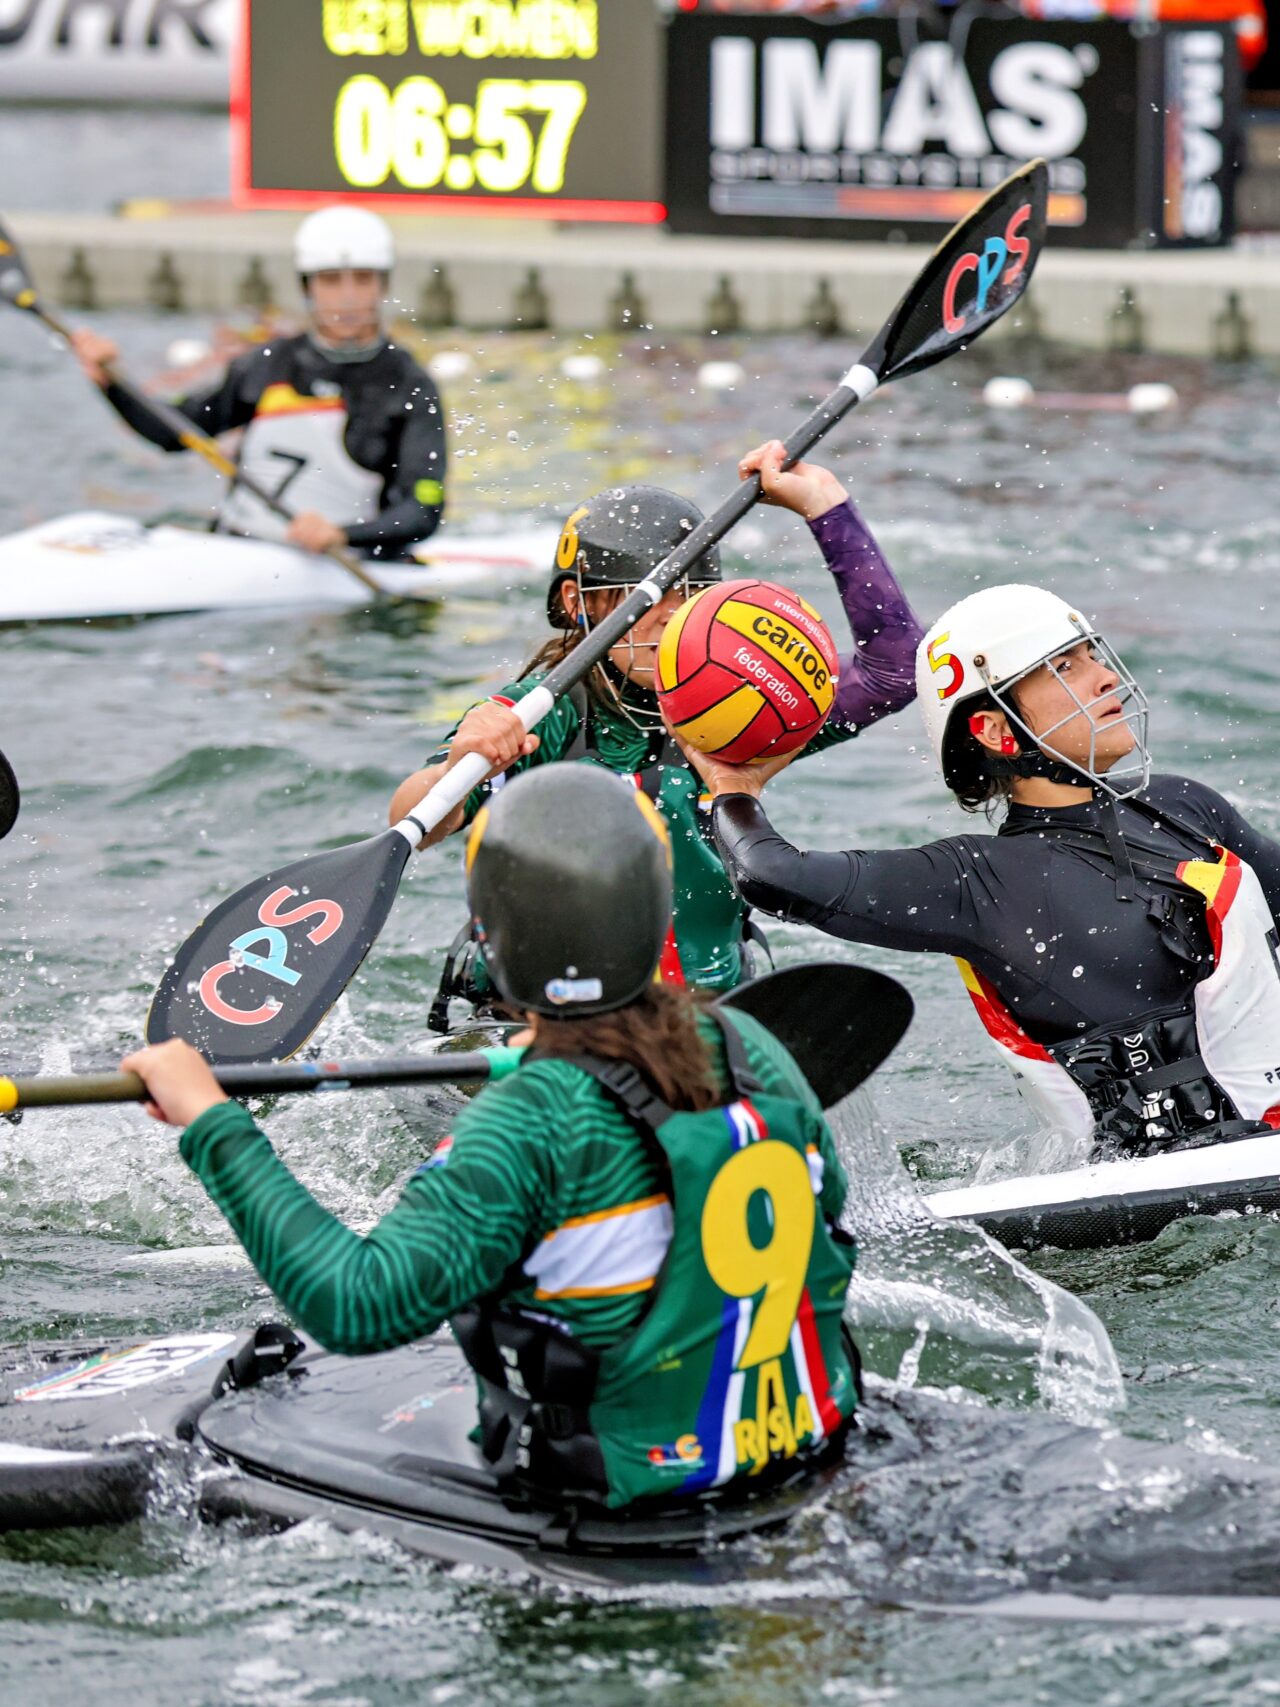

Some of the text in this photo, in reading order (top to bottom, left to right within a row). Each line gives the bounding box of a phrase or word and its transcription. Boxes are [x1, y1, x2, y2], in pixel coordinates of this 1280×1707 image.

[322, 0, 598, 58] U21 WOMEN
[334, 74, 587, 193] 06:57
[710, 37, 1087, 158] IMAS
[1181, 30, 1224, 236] IMAS
[943, 203, 1032, 334] CPS
[269, 450, 308, 504] 7
[557, 506, 589, 569] 6
[752, 616, 827, 690] canoe
[927, 631, 964, 700] 5
[200, 885, 343, 1025] CPS
[701, 1139, 816, 1369] 9
[733, 1392, 815, 1466] RSA
